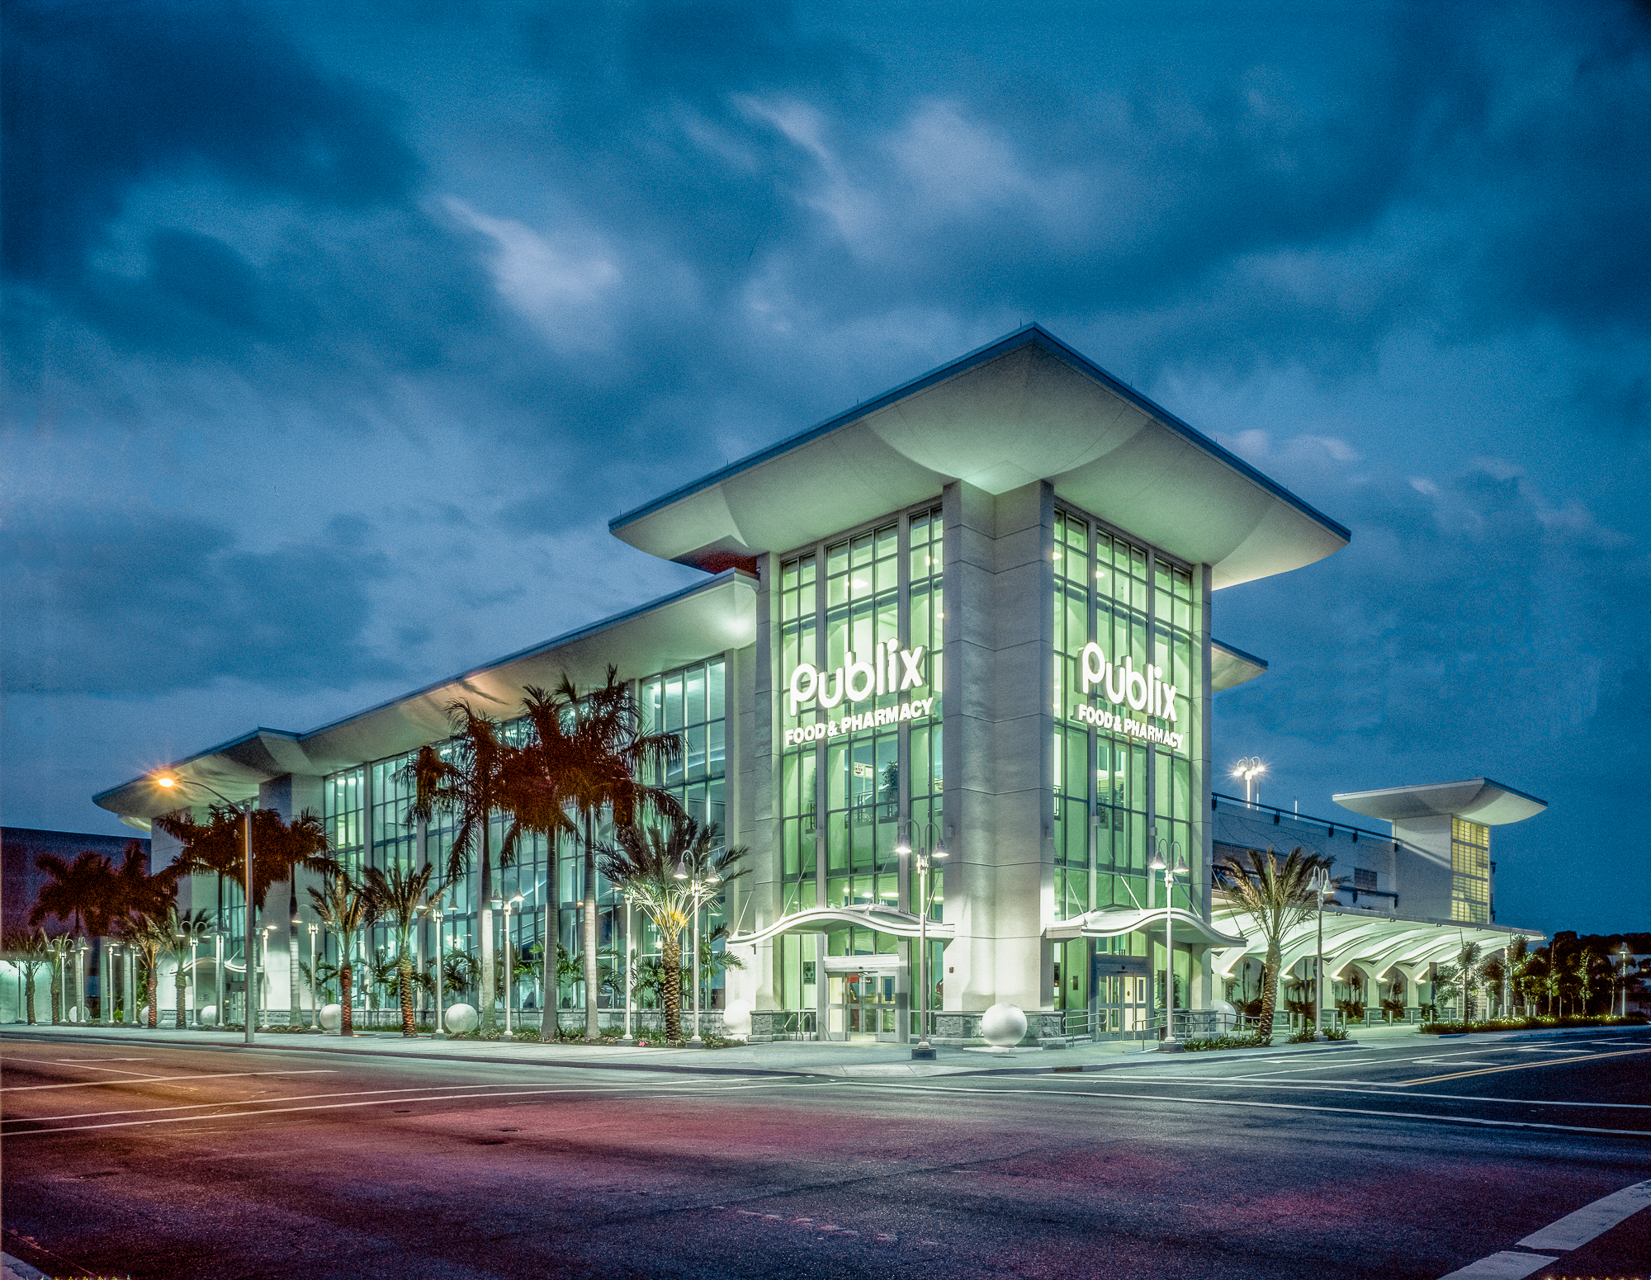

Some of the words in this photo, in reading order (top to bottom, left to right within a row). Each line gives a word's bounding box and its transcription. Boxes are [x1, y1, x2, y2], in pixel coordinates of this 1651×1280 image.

[790, 637, 927, 716] Publix
[1081, 641, 1177, 722] Publix
[785, 723, 826, 746] FOOD
[827, 720, 840, 737] &
[841, 697, 934, 734] PHARMACY
[1078, 703, 1113, 729] FOOD
[1113, 714, 1122, 733] &
[1123, 717, 1184, 749] PHARMACY
